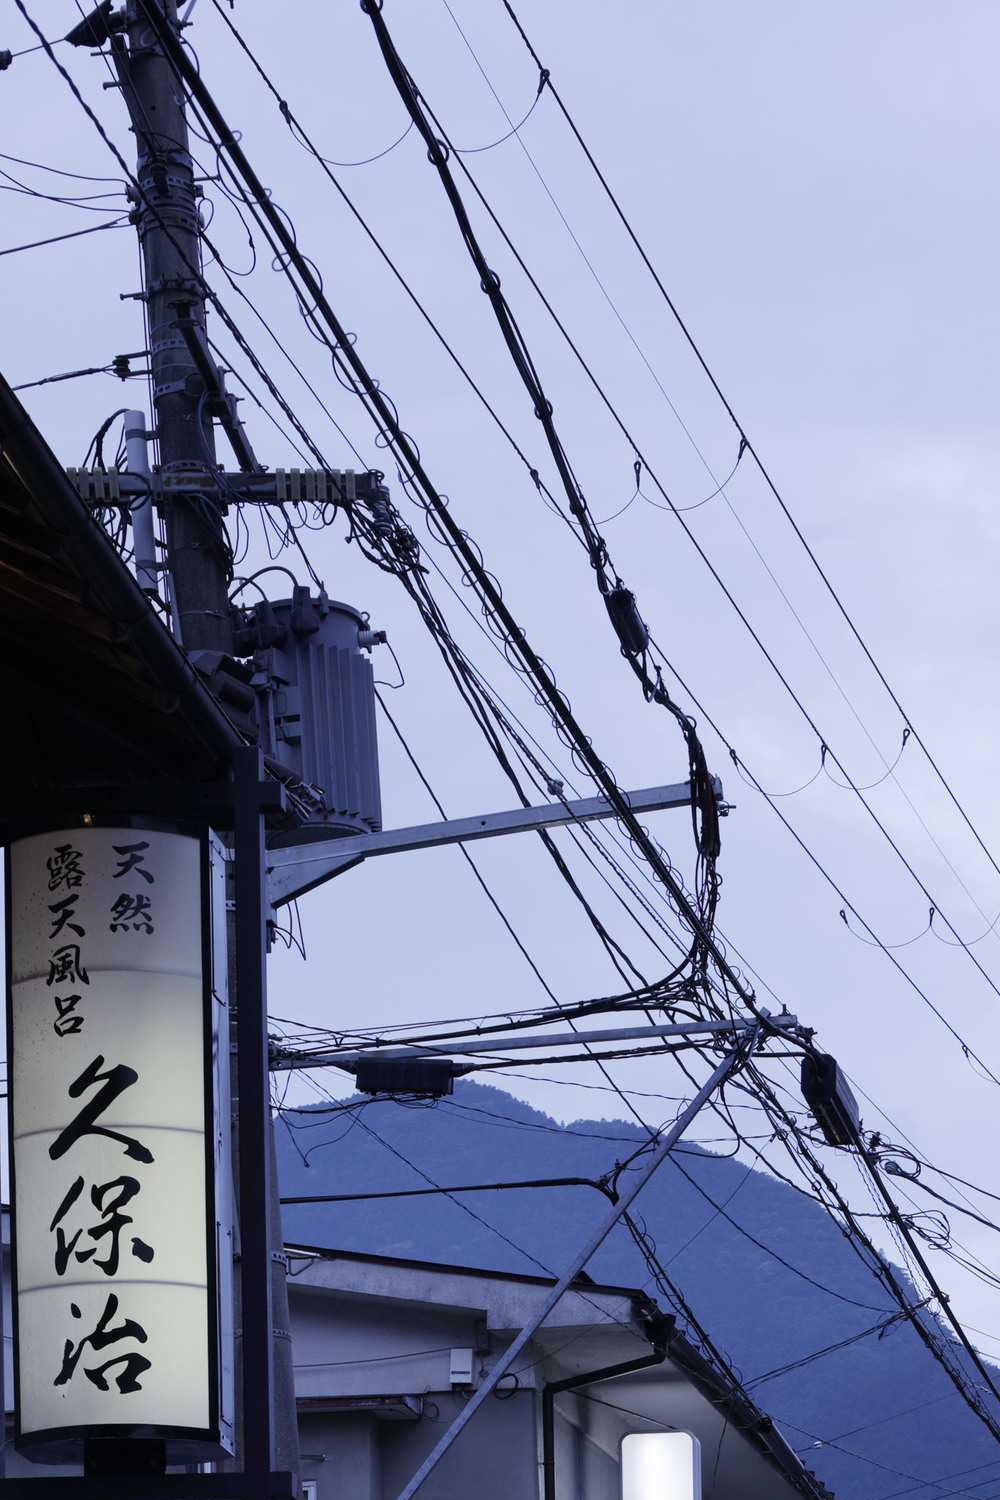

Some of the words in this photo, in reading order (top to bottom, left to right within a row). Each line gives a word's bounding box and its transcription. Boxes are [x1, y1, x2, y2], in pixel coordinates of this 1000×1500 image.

[46, 843, 90, 1037] 露天風呂
[109, 840, 155, 935] 天然
[49, 1053, 156, 1395] 久保治
